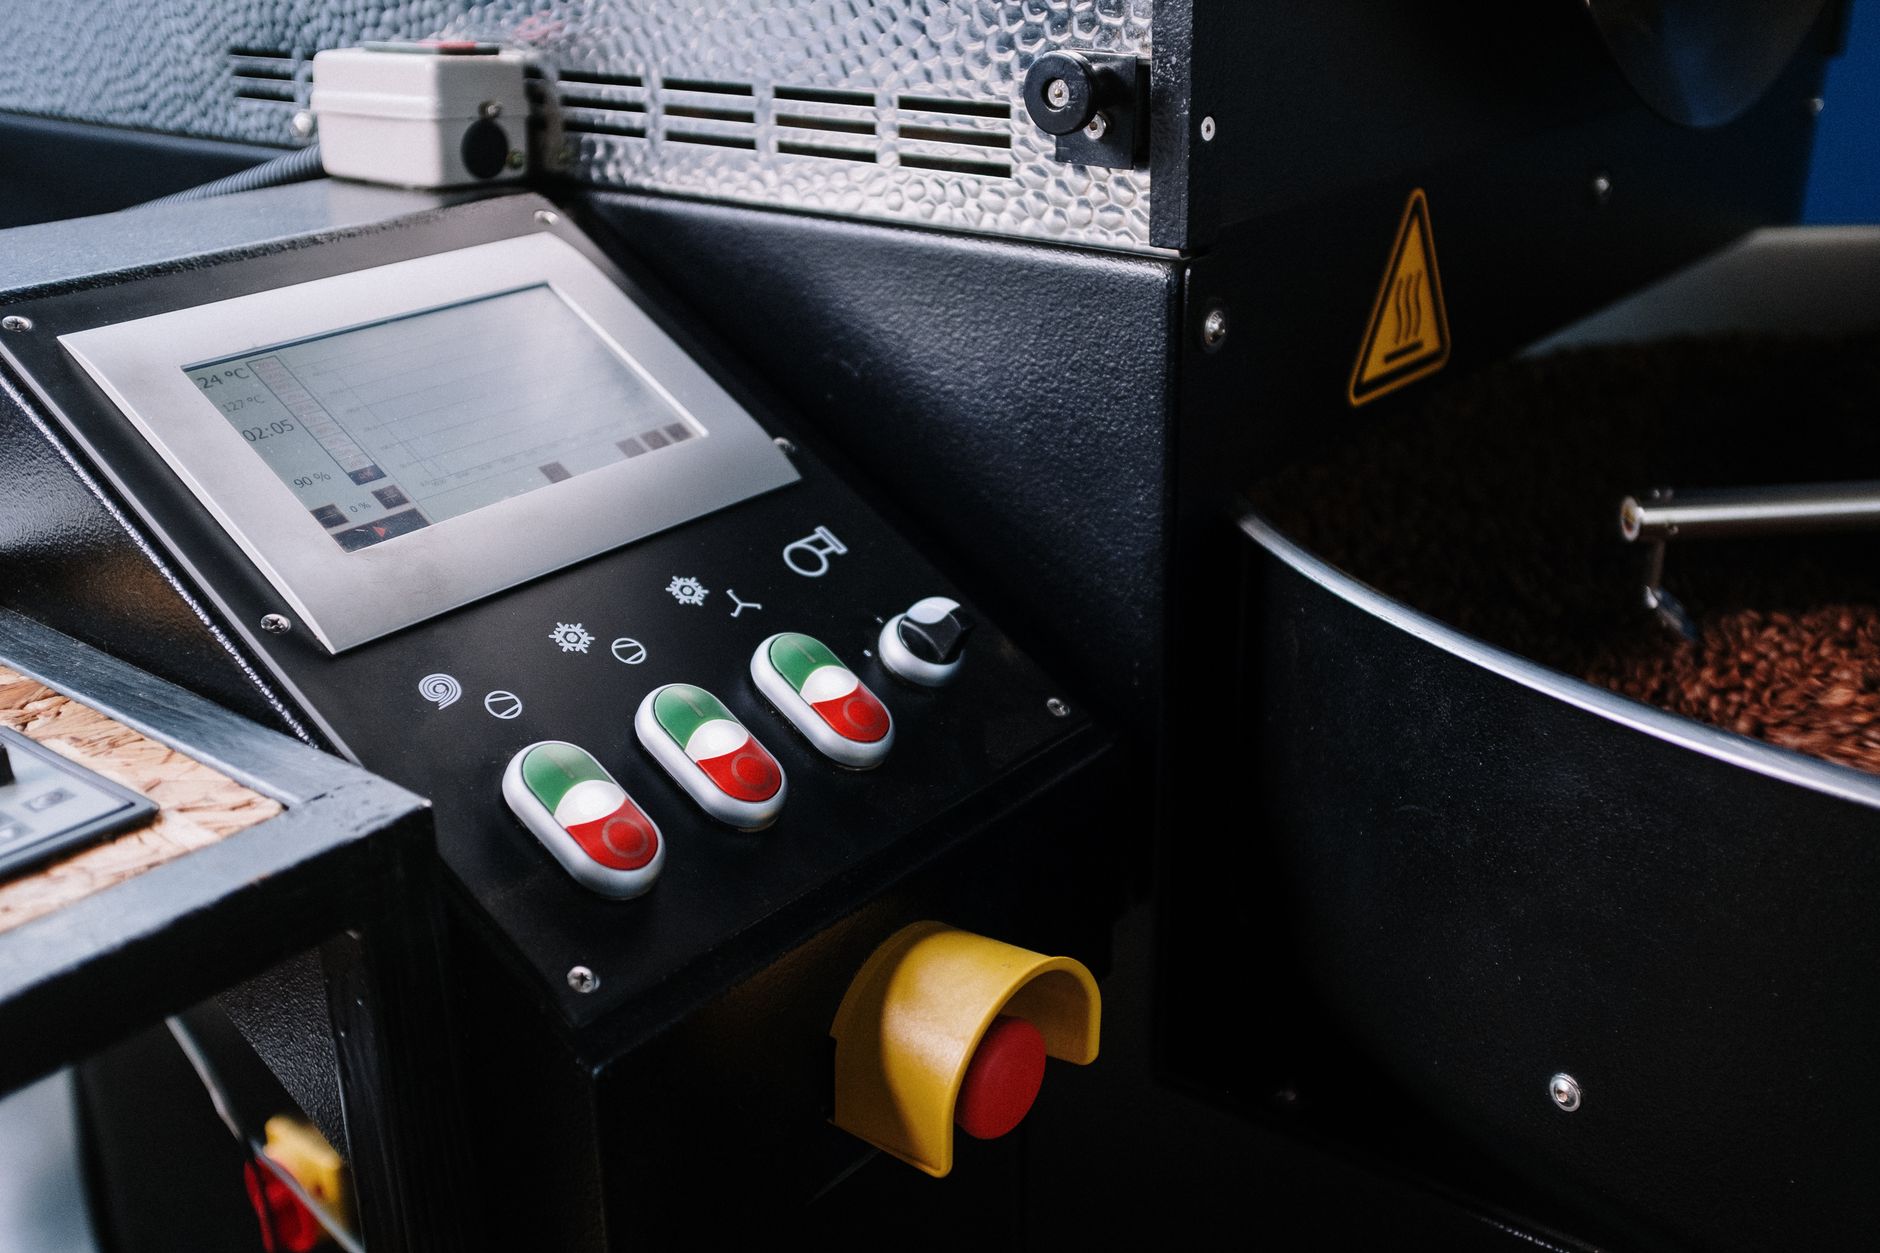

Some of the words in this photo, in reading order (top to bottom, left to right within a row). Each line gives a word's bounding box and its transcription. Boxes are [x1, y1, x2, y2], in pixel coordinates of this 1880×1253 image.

[197, 374, 223, 390] 24
[223, 399, 244, 413] 127
[242, 419, 294, 442] 02:05
[294, 476, 313, 489] 90
[313, 472, 331, 481] %
